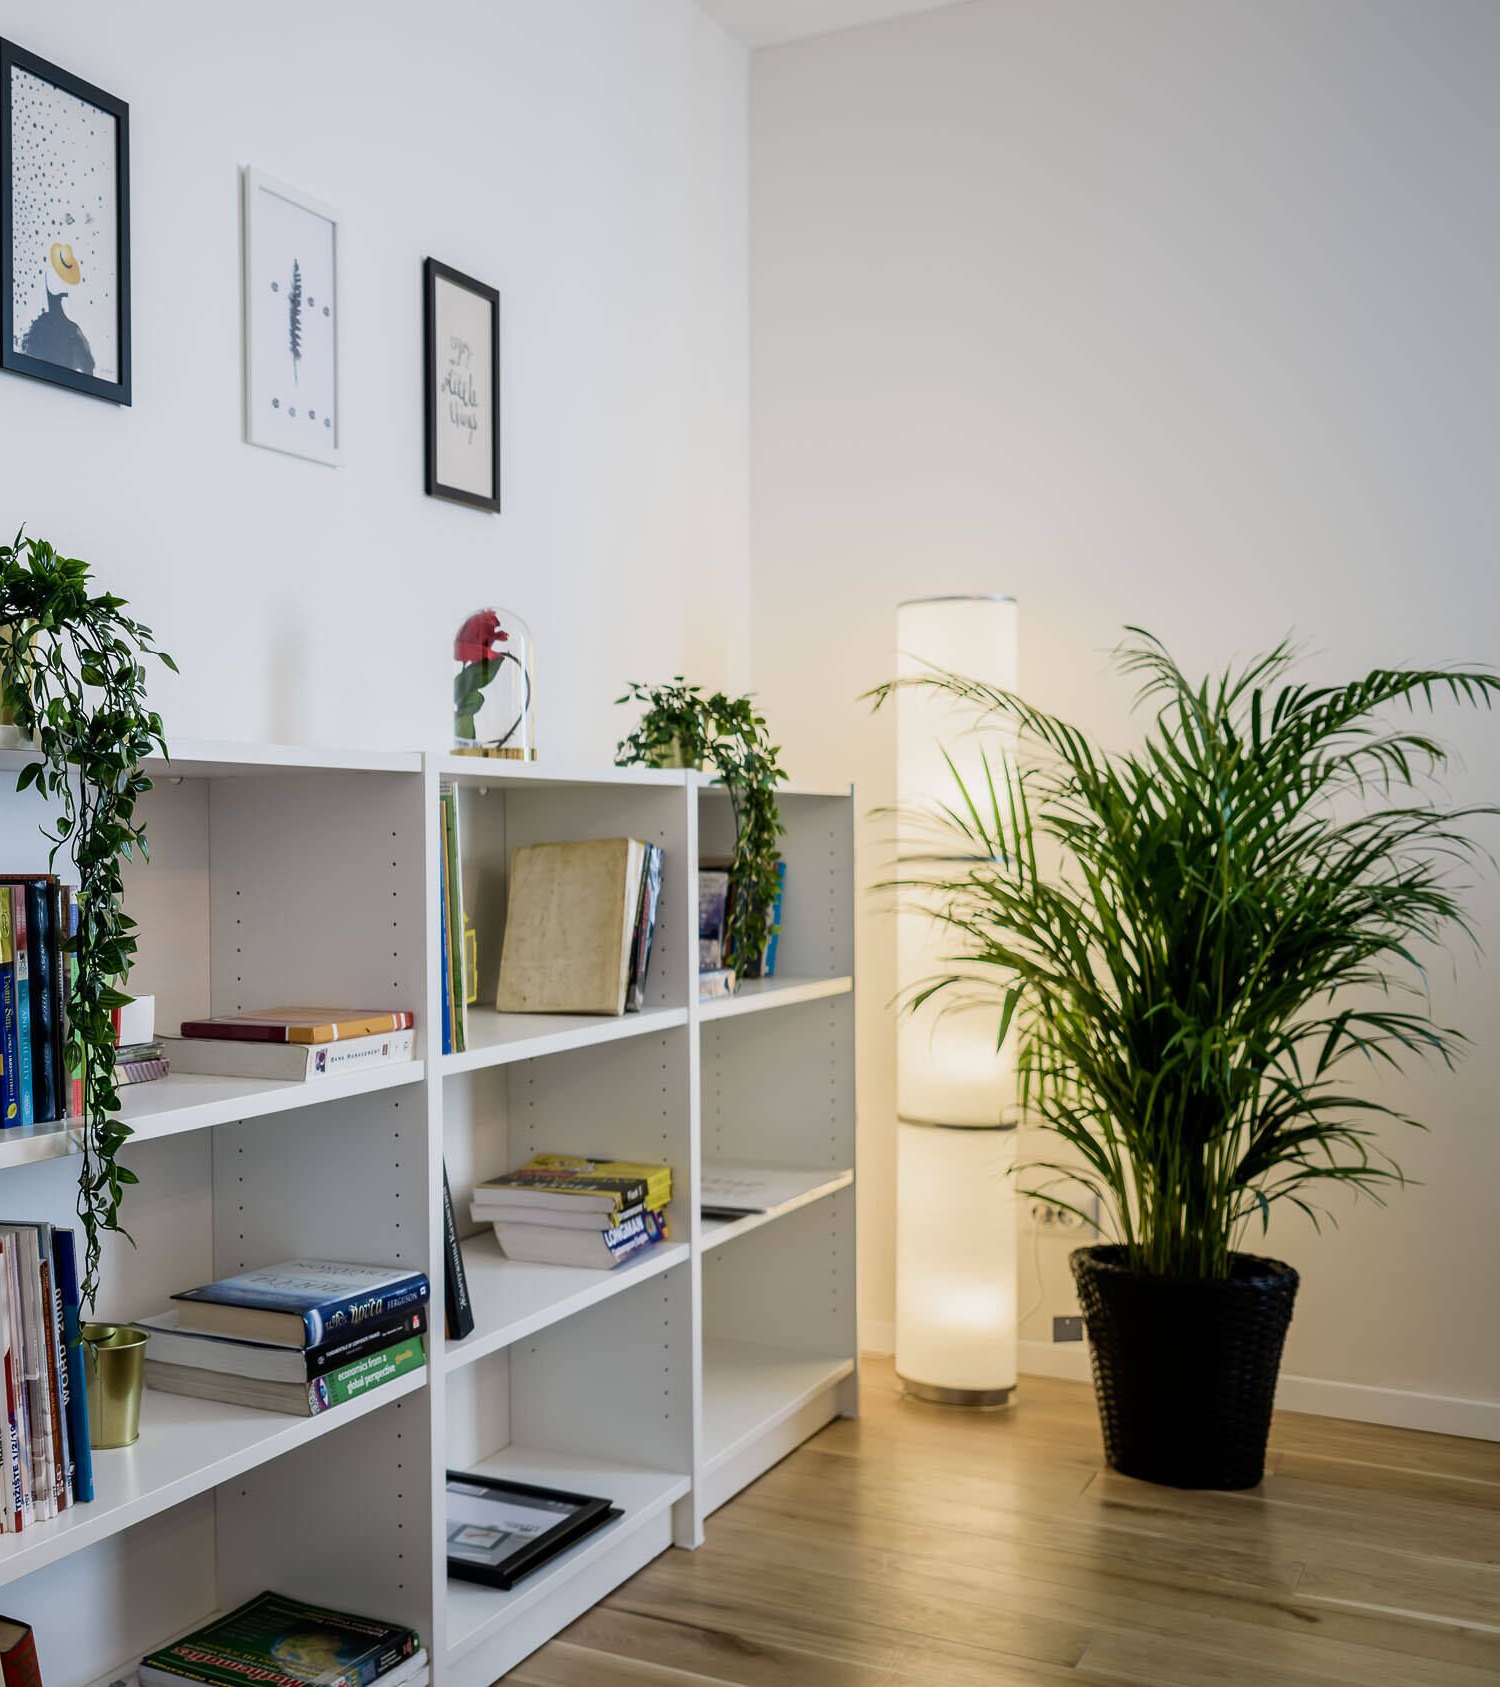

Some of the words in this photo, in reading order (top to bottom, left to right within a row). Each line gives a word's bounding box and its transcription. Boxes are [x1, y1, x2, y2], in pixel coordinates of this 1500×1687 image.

[604, 1213, 644, 1247] LONGMAN
[54, 1287, 65, 1333] 2000
[387, 1291, 418, 1309] FERGUSON
[58, 1344, 71, 1406] WORD
[338, 1363, 368, 1382] economics
[368, 1355, 383, 1368] from
[383, 1354, 388, 1362] a
[347, 1376, 365, 1395] global
[364, 1364, 396, 1387] perspective
[8, 1411, 19, 1461] 1/2/19
[11, 1464, 23, 1512] TRŽIŠTE
[169, 1645, 304, 1687] Mathematics
